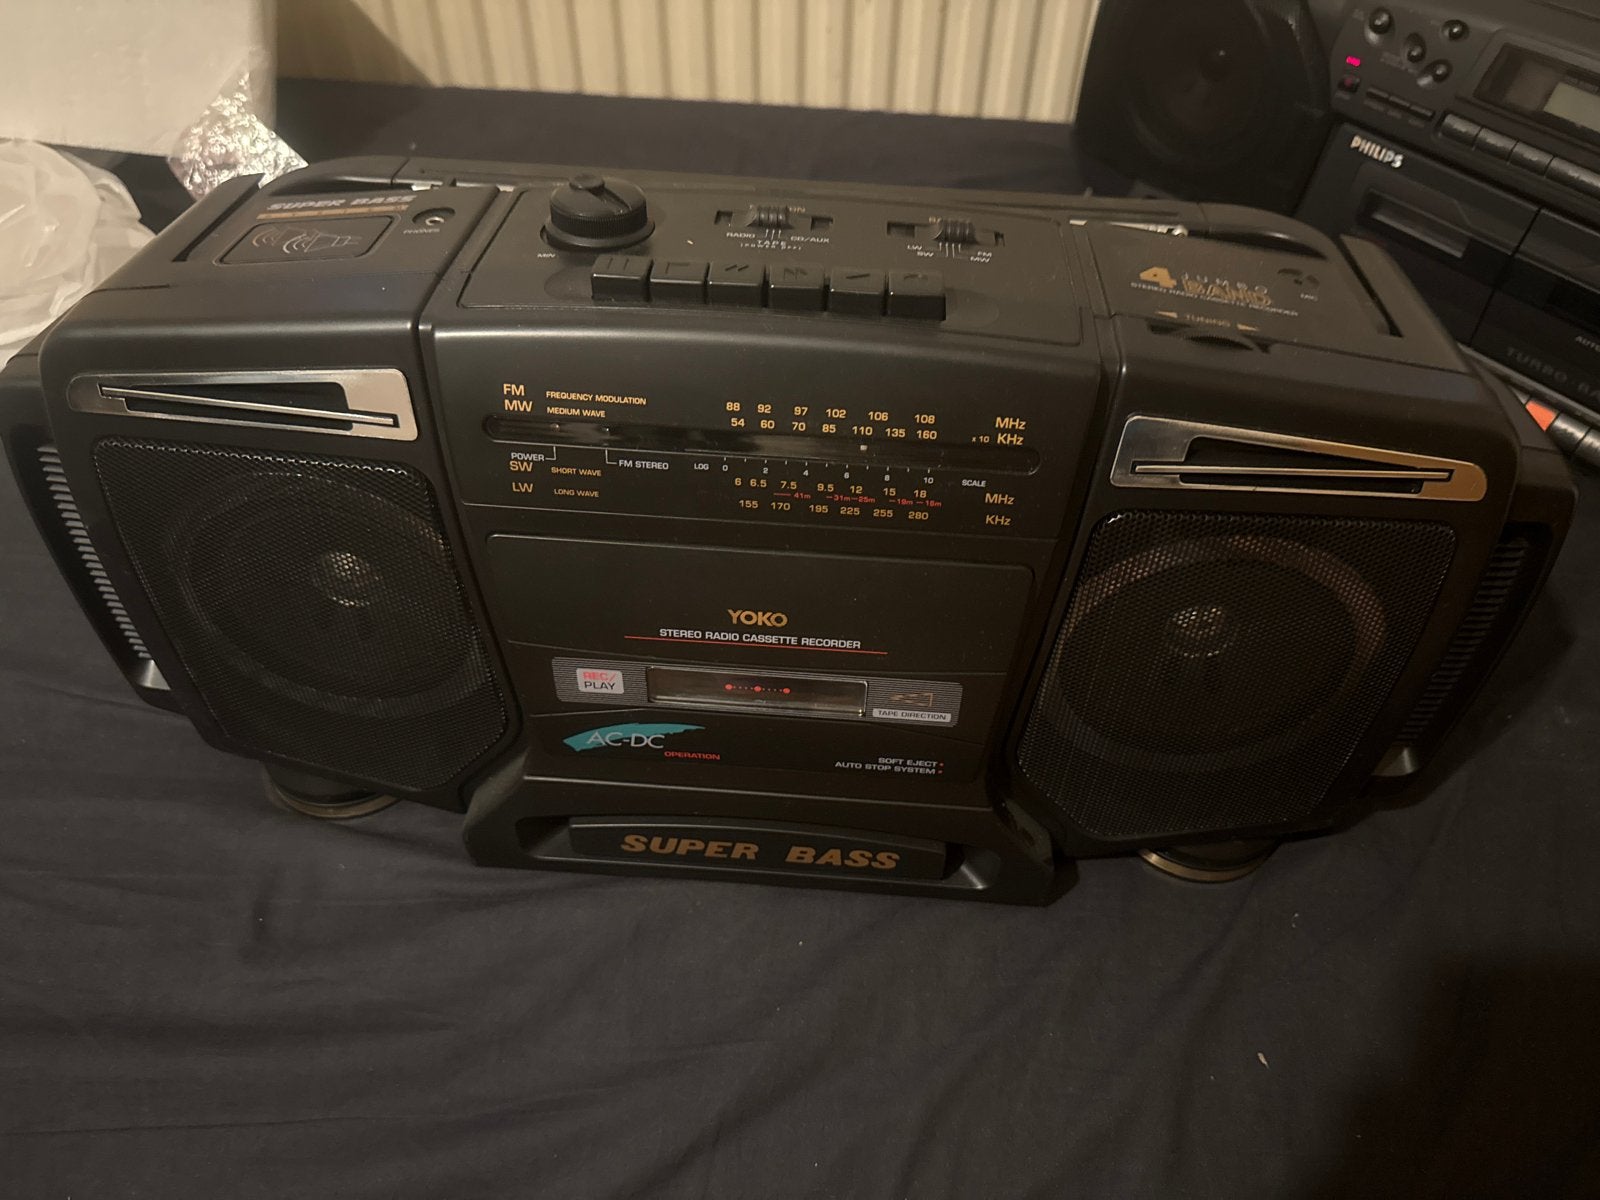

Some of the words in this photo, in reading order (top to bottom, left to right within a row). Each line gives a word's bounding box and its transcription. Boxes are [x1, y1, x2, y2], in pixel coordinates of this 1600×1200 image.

[1350, 134, 1404, 168] PHILIPS
[266, 200, 346, 210] SUPER
[350, 195, 418, 206] BASS
[1140, 266, 1177, 288] 4
[503, 383, 525, 396] FM
[546, 391, 593, 402] FREQUENCY
[595, 394, 647, 405] MODULATION
[504, 399, 532, 413] MW
[547, 407, 580, 416] MEDIUM
[582, 409, 606, 418] WAVE
[726, 402, 740, 412] 88
[757, 404, 772, 414] 92
[794, 406, 808, 416] 97
[825, 408, 846, 419] 102
[868, 411, 889, 421] 106
[914, 414, 935, 424] 108
[995, 416, 1026, 430] MHz
[730, 418, 745, 428] 54
[760, 420, 775, 430] 60
[792, 422, 806, 432] 70
[822, 424, 836, 434] 85
[852, 426, 873, 436] 110
[885, 428, 906, 438] 135
[916, 430, 937, 440] 160
[978, 435, 990, 444] 10
[997, 433, 1024, 446] KHz
[511, 452, 545, 462] POWER
[635, 461, 669, 470] STEREO
[509, 461, 533, 472] SW
[551, 467, 577, 475] SHORT
[579, 469, 602, 477] WAVE
[512, 482, 533, 493] LW
[554, 489, 575, 497] LONG
[576, 490, 600, 498] WAVE
[734, 478, 742, 486] 6
[750, 479, 767, 488] 6.5
[780, 480, 797, 490] 7.5
[817, 483, 834, 493] 9.5
[850, 485, 863, 494] 12
[883, 487, 896, 496] 15
[914, 490, 927, 499] 18
[984, 492, 1015, 506] MHz
[962, 479, 986, 488] SCALE
[739, 500, 759, 509] 155
[770, 502, 791, 511] 170
[809, 504, 829, 514] 195
[840, 506, 860, 516] 225
[873, 508, 894, 518] 255
[908, 511, 929, 520] 280
[985, 515, 1012, 526] KHz
[727, 609, 788, 628] YOKO
[659, 628, 702, 640] STEREO
[705, 631, 740, 642] RADIO
[742, 634, 798, 646] CASSETTE
[800, 637, 861, 650] RECORDER
[583, 672, 616, 682] REC/
[584, 681, 616, 690] PLAY
[901, 711, 947, 720] DIRECTION
[586, 731, 665, 750] AC-DC
[664, 750, 720, 761] OPERATION
[877, 757, 904, 766] SOFT
[907, 759, 938, 768] EJECT
[834, 761, 862, 770] AUTO
[864, 763, 891, 772] STOP
[894, 765, 936, 775] SYSTEM
[620, 834, 760, 862] SUPER
[785, 846, 901, 870] BASS
